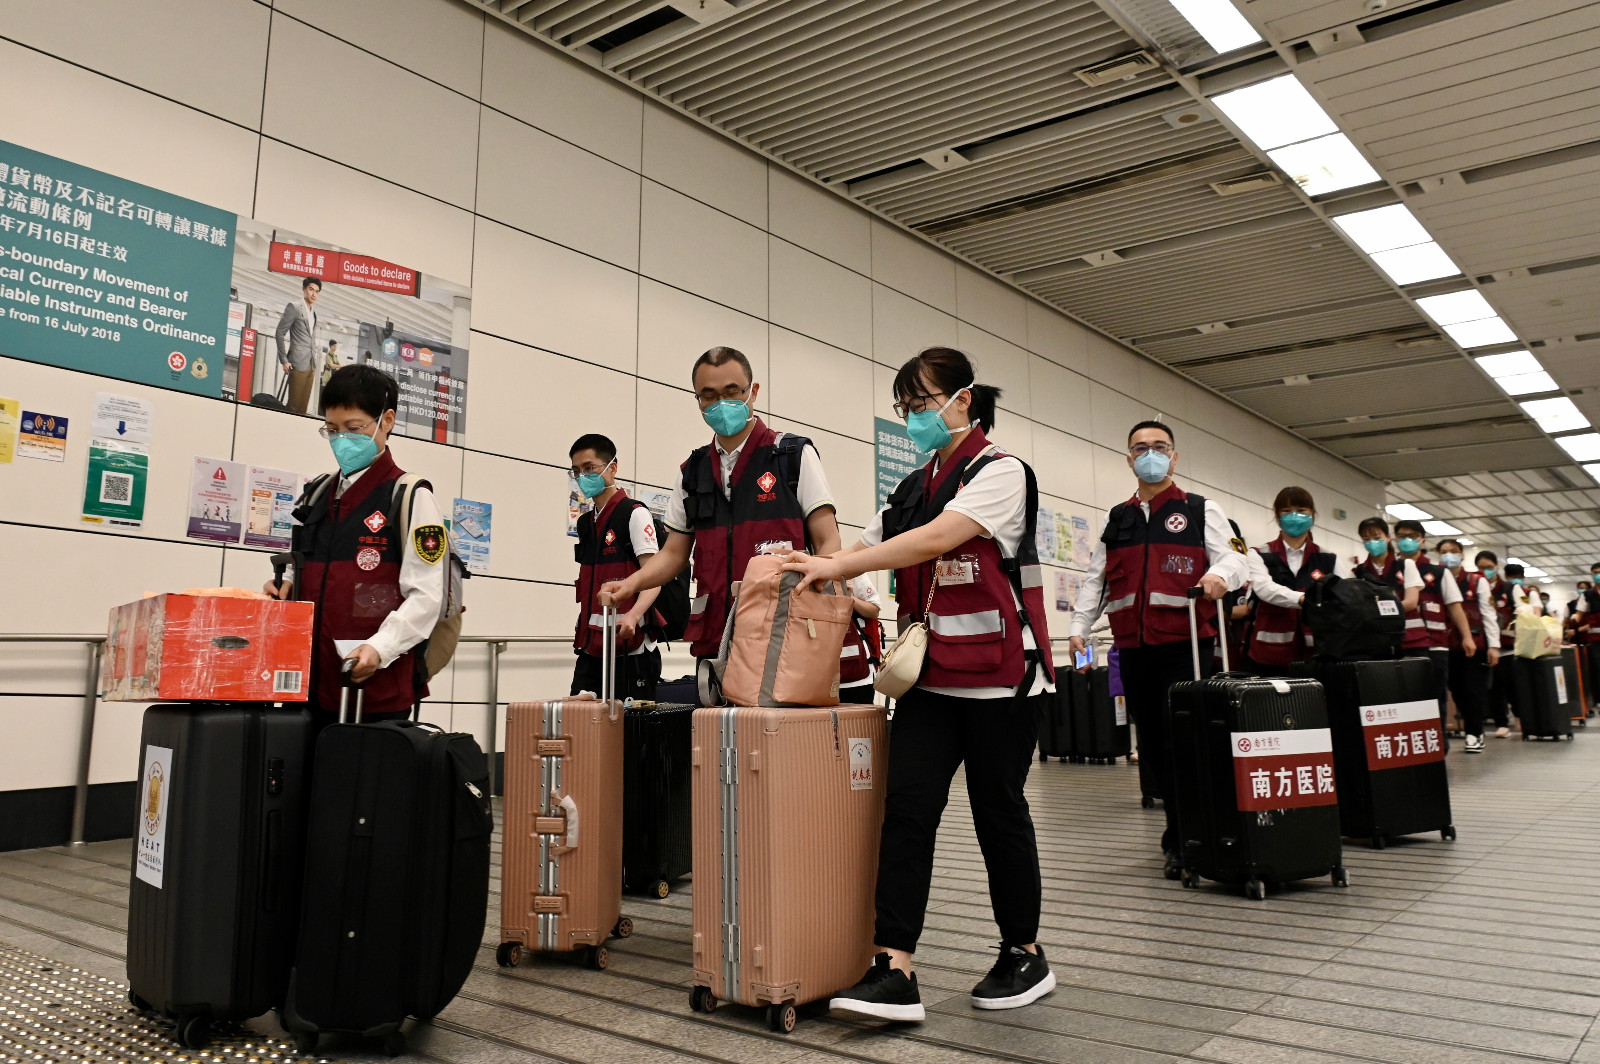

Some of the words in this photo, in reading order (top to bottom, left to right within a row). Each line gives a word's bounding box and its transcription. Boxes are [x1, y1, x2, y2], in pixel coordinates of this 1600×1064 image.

[93, 267, 170, 299] Movement
[174, 290, 189, 303] of
[343, 260, 369, 275] Goods
[370, 265, 379, 277] to
[381, 266, 412, 281] declare
[0, 266, 24, 281] cal
[29, 271, 103, 302] Currency
[106, 292, 135, 308] and
[139, 298, 187, 320] Bearer
[0, 284, 40, 305] iable
[44, 294, 138, 328] Instruments
[142, 316, 216, 346] Ordinance
[9, 307, 40, 324] from
[44, 316, 59, 328] 16
[61, 320, 89, 337] July
[91, 326, 121, 342] 2018
[400, 382, 428, 395] disclose
[428, 389, 456, 403] currency
[424, 397, 462, 414] instruments
[409, 407, 449, 421] HKD120,000
[1374, 728, 1440, 760] 南方医院
[1250, 763, 1335, 799] 南方医院
